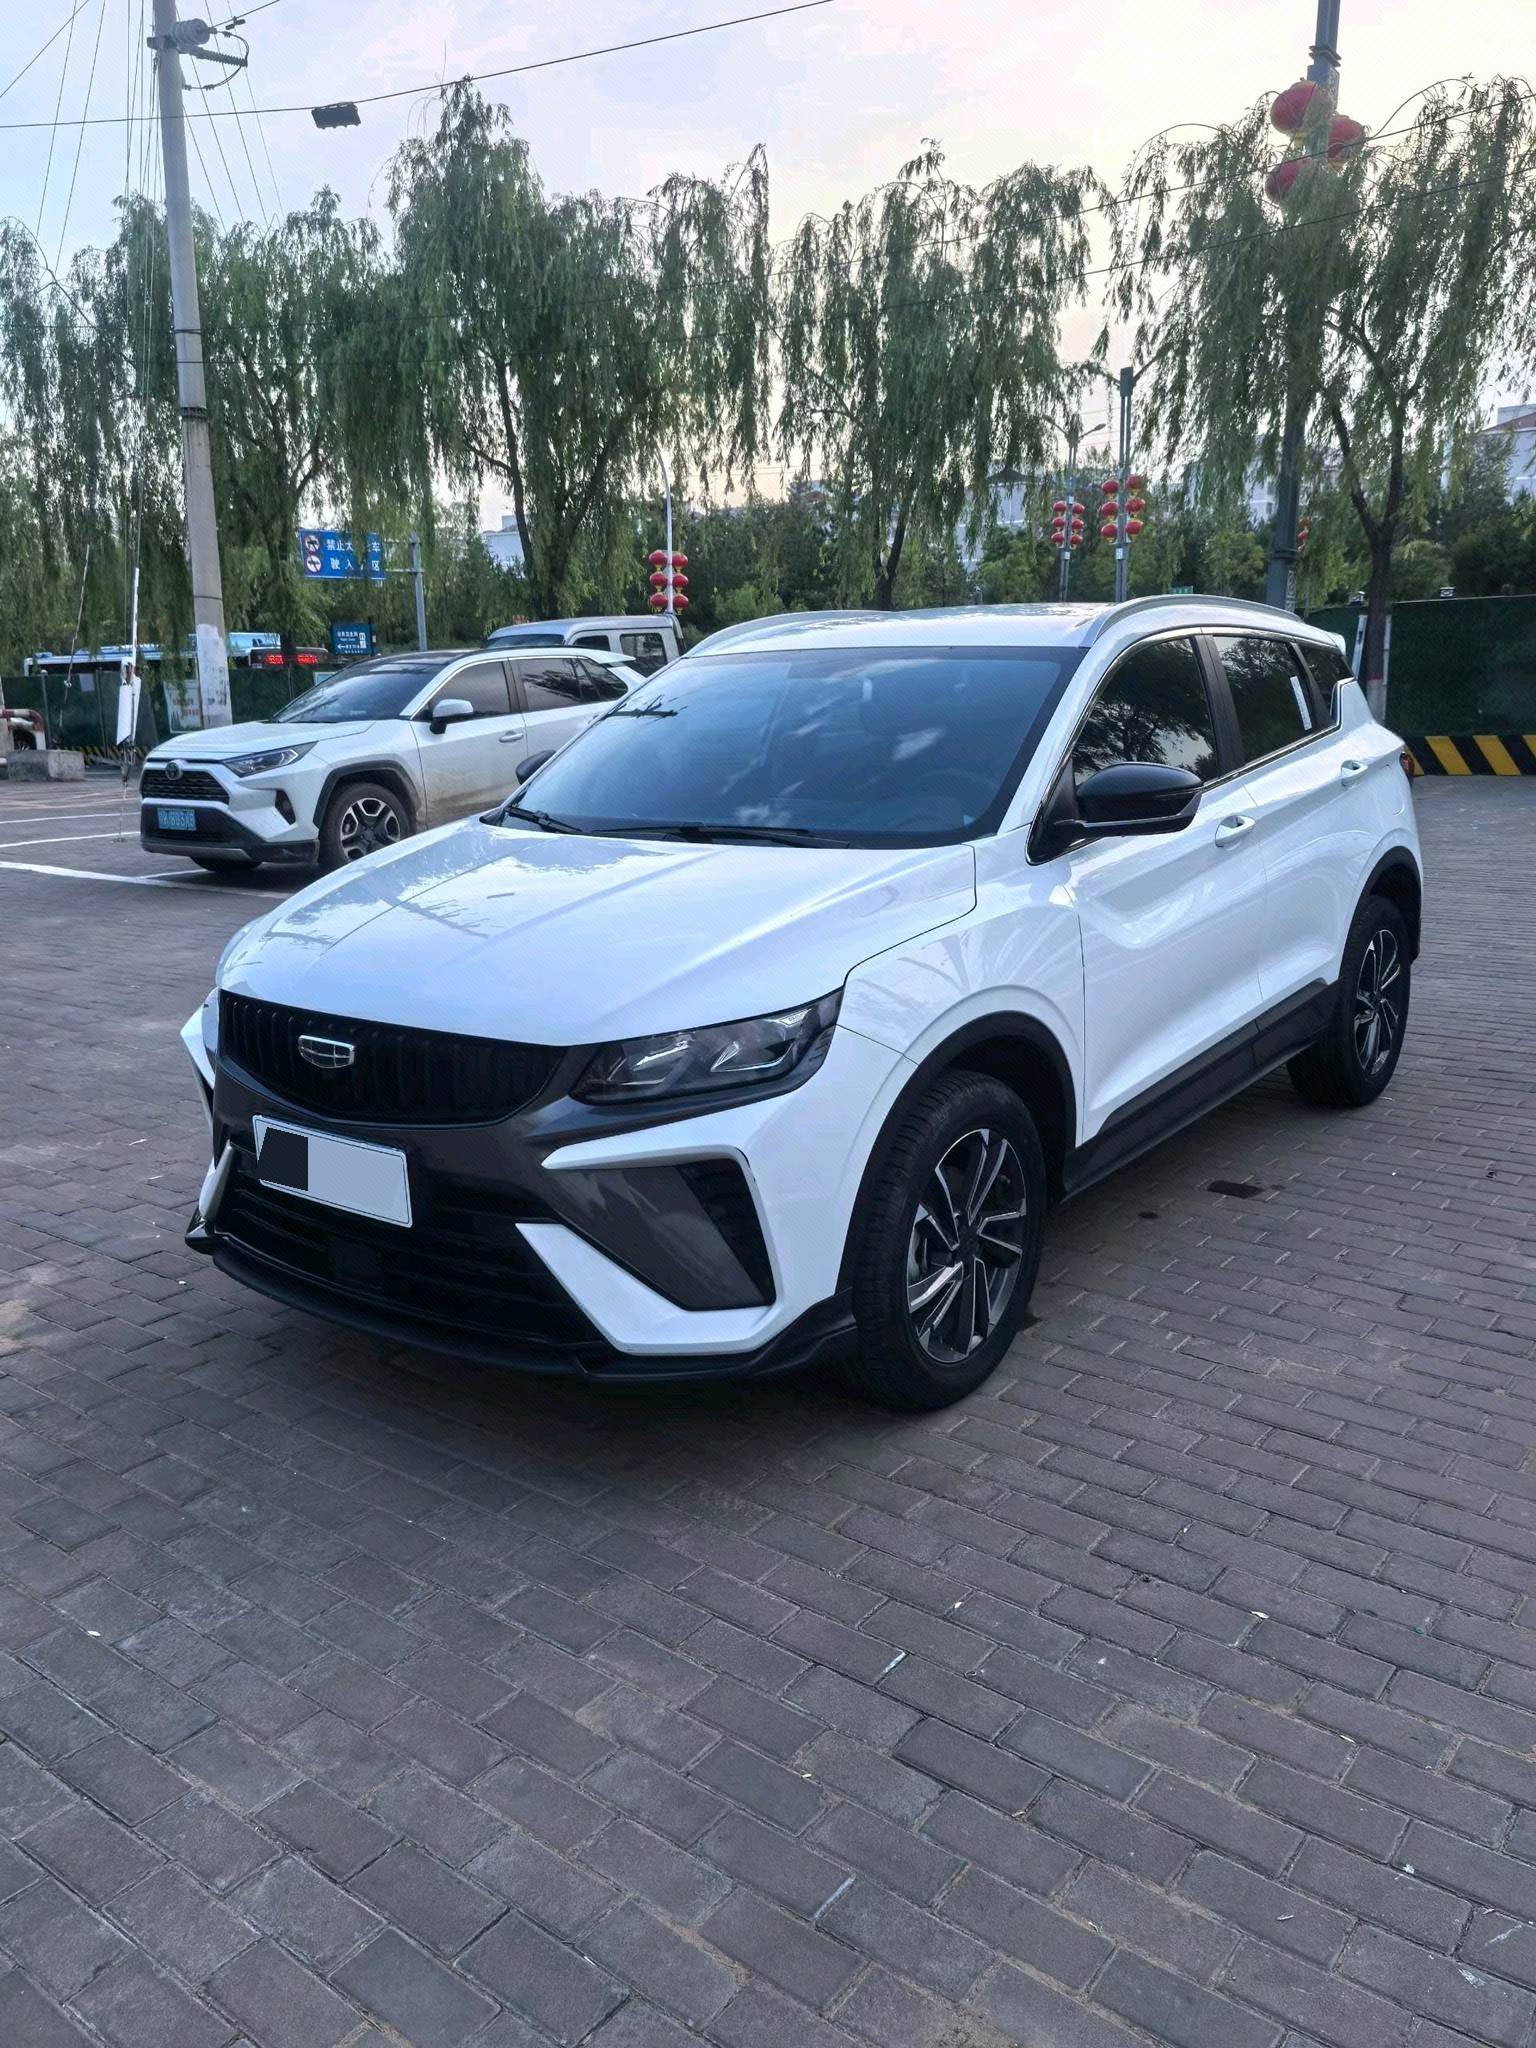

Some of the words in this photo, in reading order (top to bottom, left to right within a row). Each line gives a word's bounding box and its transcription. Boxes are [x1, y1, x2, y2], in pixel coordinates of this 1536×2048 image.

[326, 539, 381, 552] 禁止大车
[329, 557, 380, 571] 驶入区
